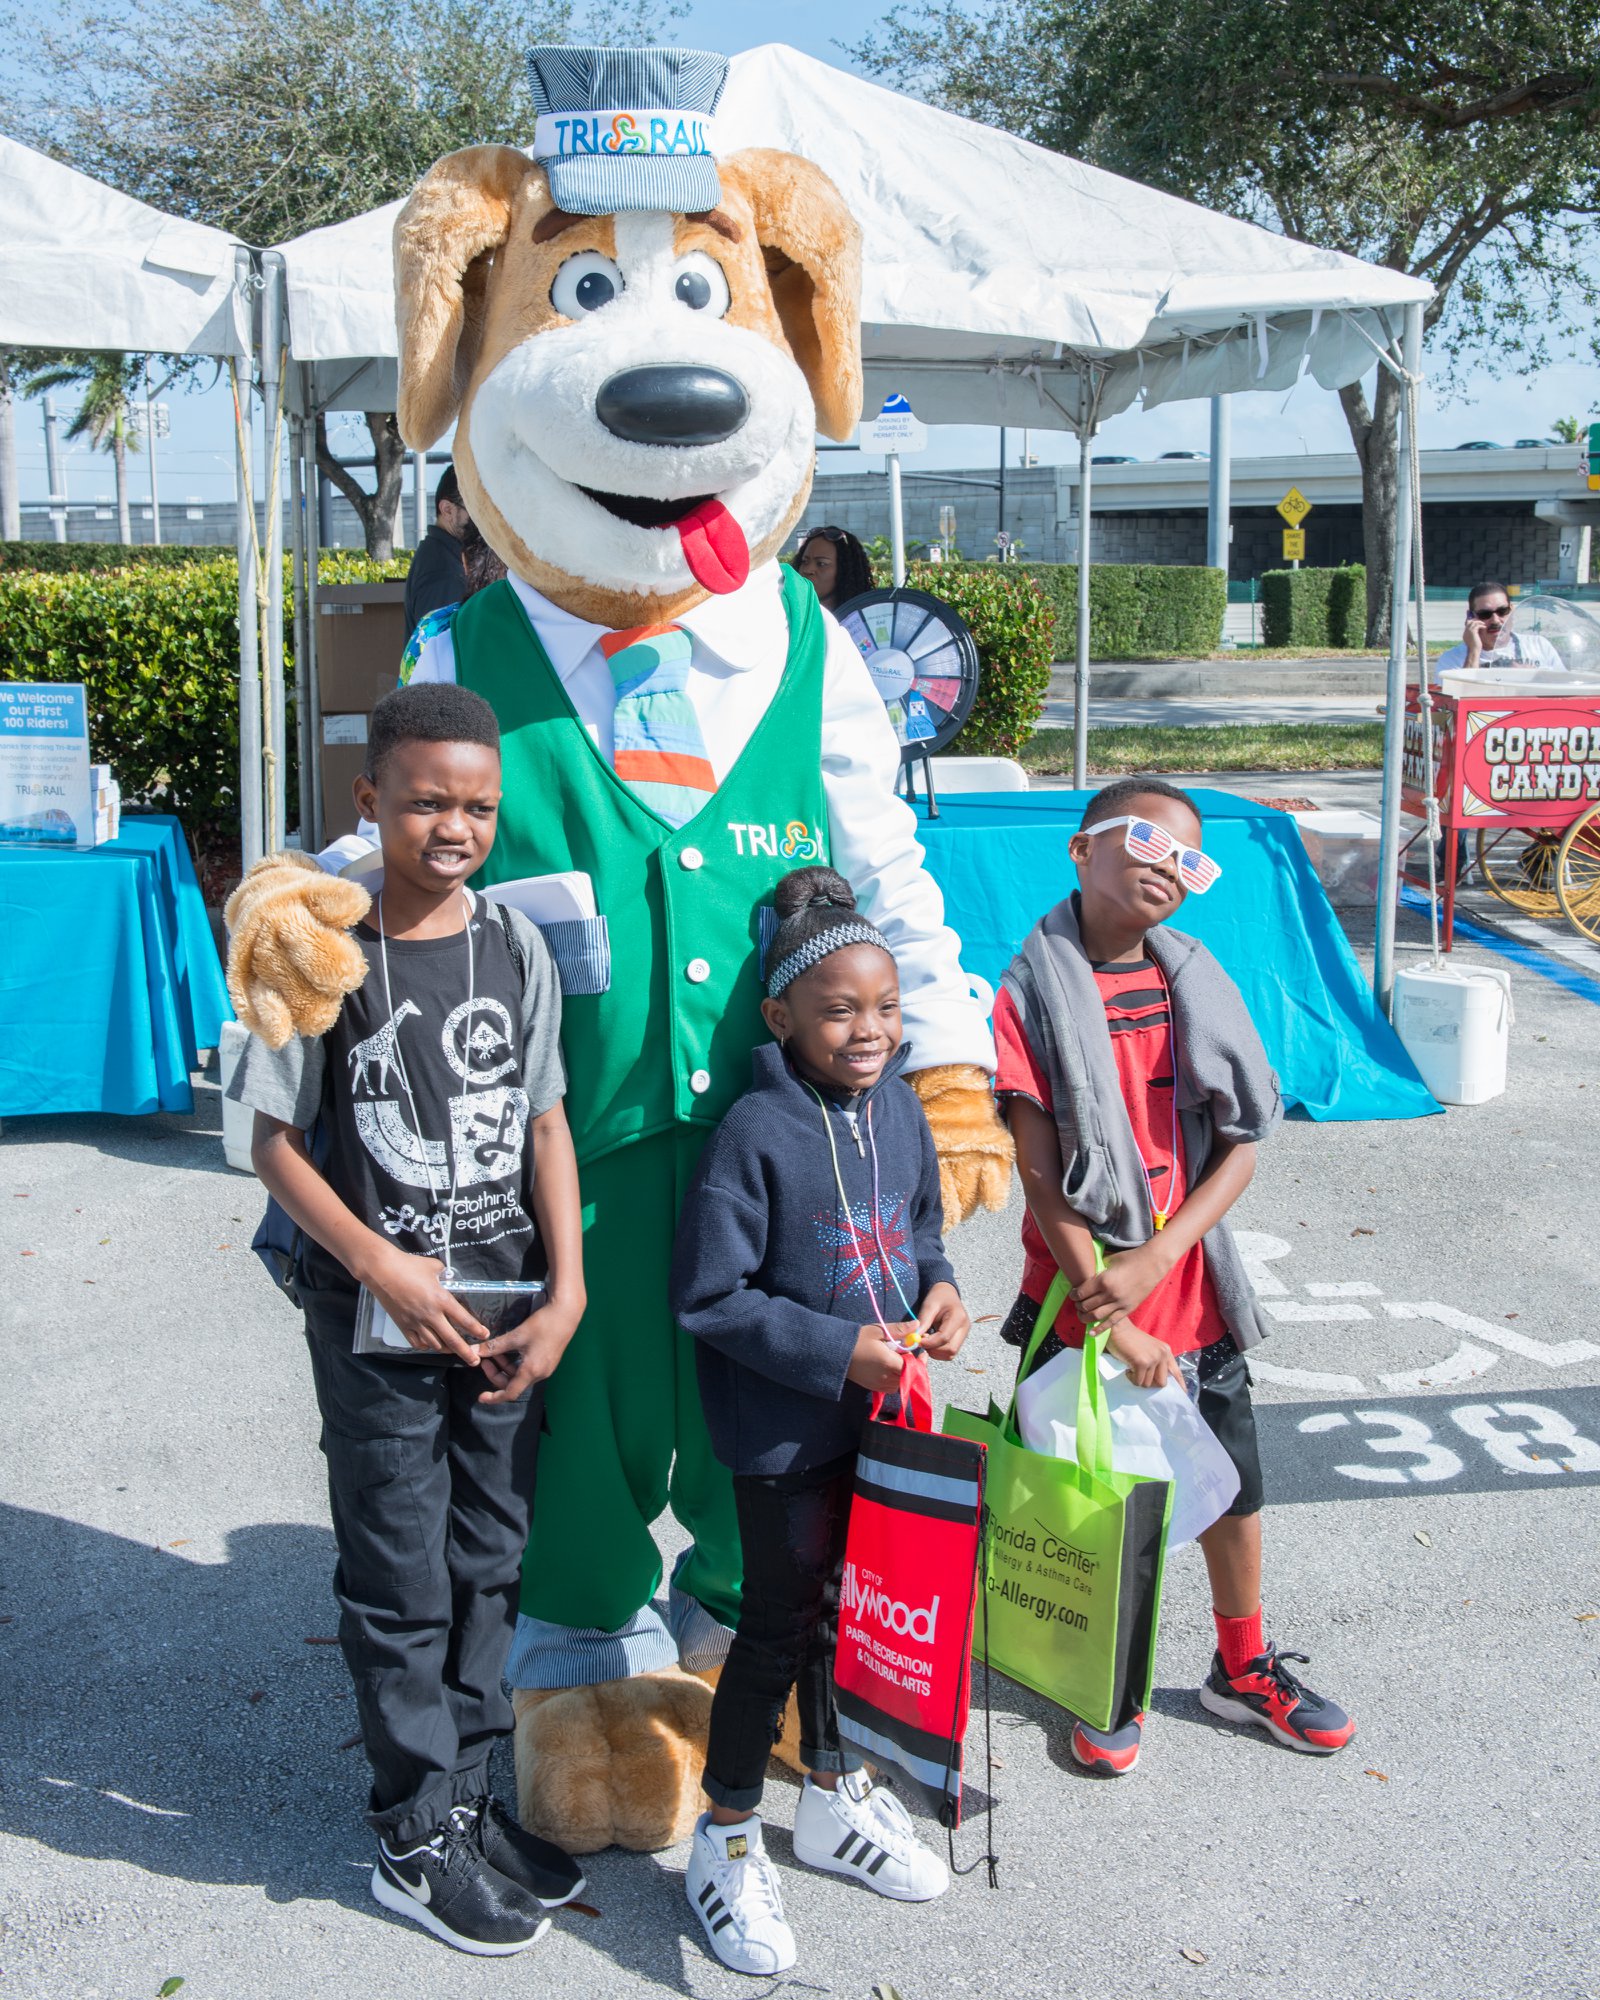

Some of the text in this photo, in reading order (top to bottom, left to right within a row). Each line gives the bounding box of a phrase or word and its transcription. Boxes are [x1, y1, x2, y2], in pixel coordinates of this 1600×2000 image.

[554, 117, 713, 155] TRI RAIL
[8, 705, 62, 716] our First
[17, 692, 75, 704] Welcome
[3, 717, 69, 729] 100 Riders!
[16, 785, 66, 796] TRI RAIL
[727, 822, 778, 857] TRI
[454, 1187, 516, 1215] clothing
[1298, 1401, 1600, 1484] 38
[862, 1568, 883, 1587] CITY OF
[1025, 1560, 1033, 1572] &
[1036, 1563, 1070, 1586] Asthma
[1073, 1577, 1093, 1596] Care
[857, 1647, 931, 1697] & CULTURAL ARTS
[873, 1639, 933, 1678] RECREATION
